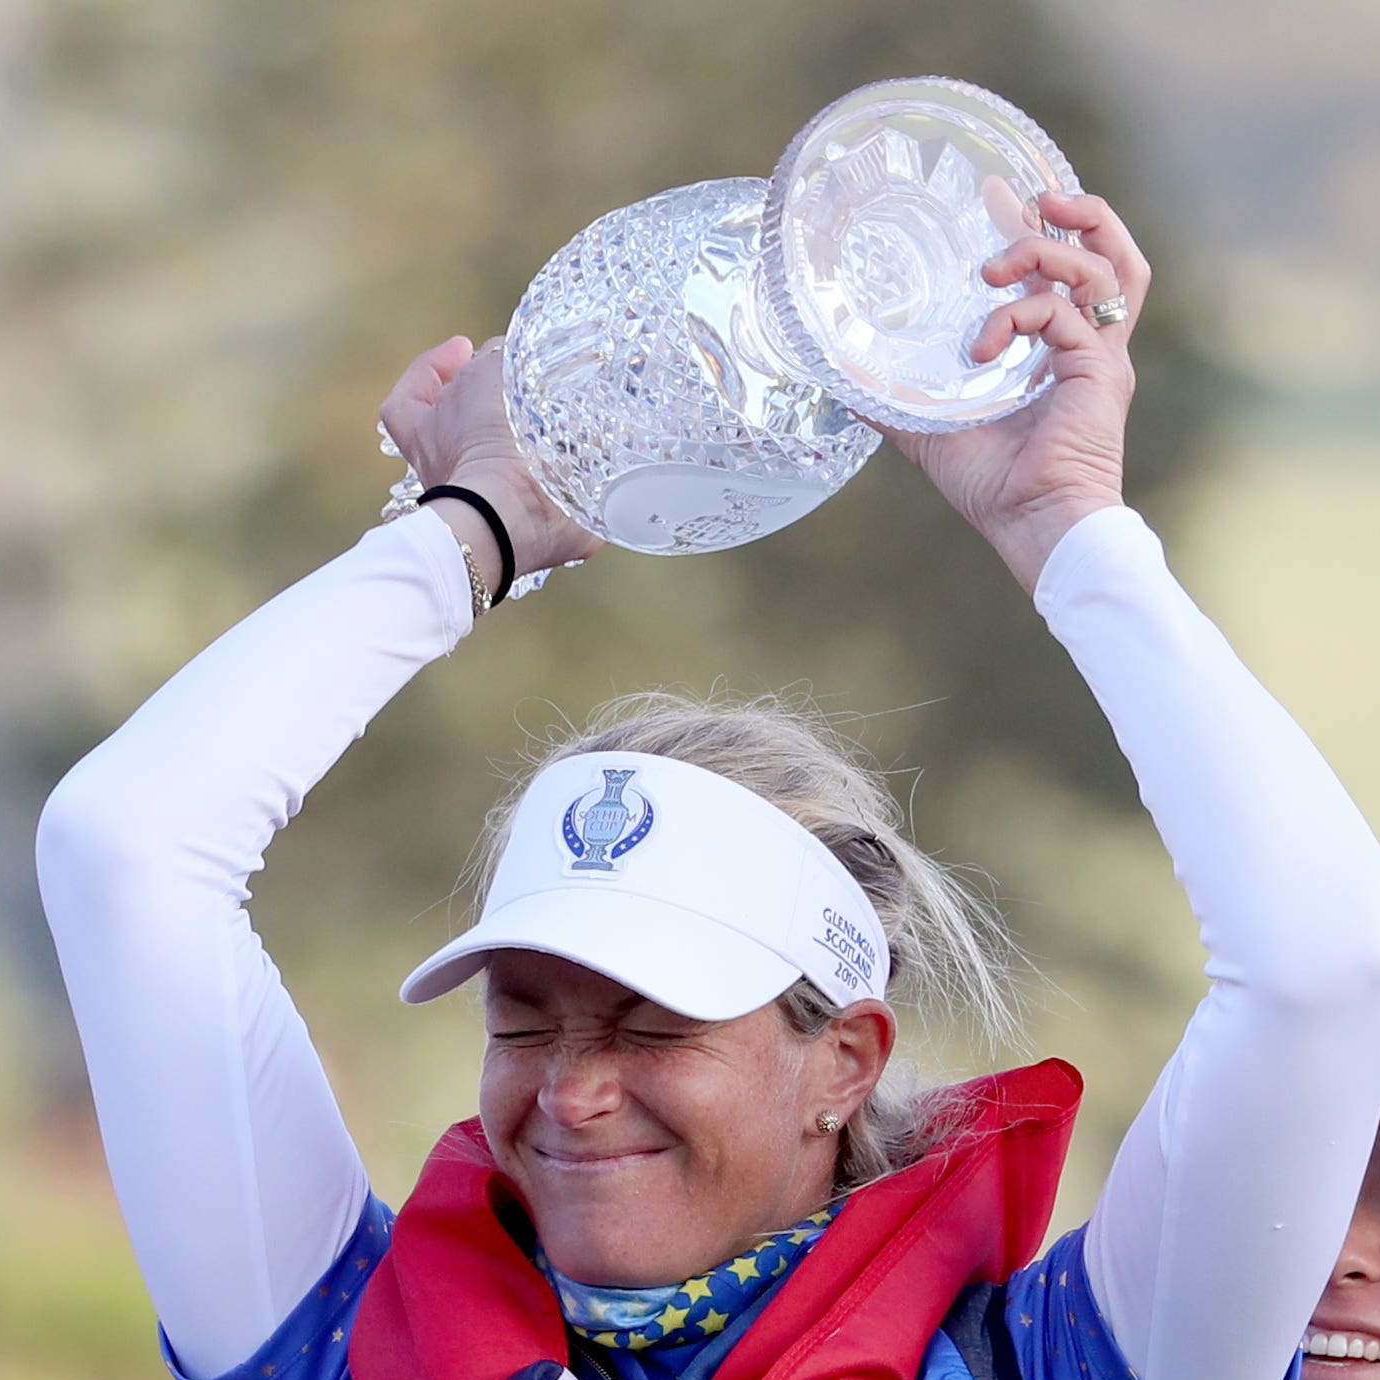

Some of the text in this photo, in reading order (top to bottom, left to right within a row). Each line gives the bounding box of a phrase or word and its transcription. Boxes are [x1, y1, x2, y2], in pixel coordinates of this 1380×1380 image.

[589, 821, 618, 832] CUP
[824, 927, 872, 980] SCOTLAND
[834, 961, 858, 990] 2019
